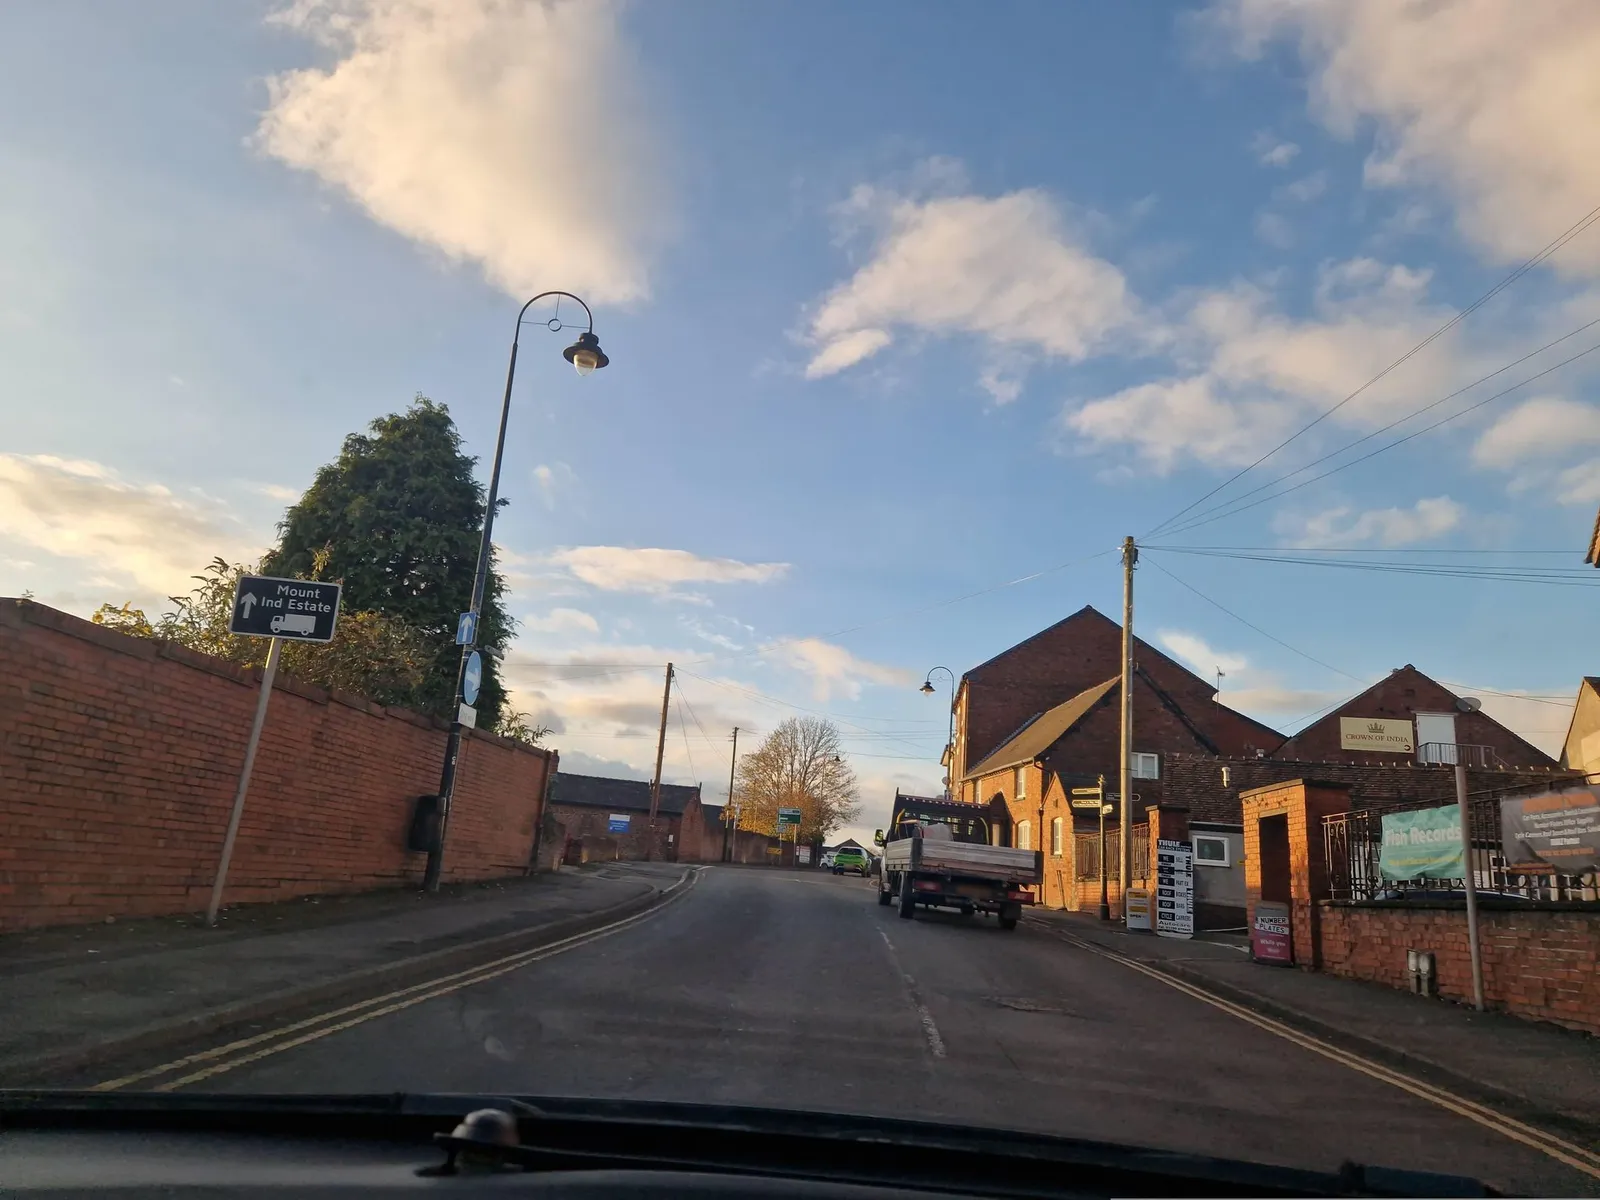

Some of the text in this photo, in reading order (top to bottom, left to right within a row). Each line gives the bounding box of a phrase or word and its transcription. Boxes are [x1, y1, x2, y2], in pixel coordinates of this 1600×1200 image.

[276, 584, 321, 599] Mount
[261, 596, 331, 613] Ind Estate
[1387, 735, 1409, 743] INDIA
[1409, 823, 1462, 845] Records
[1158, 839, 1180, 847] THULE
[1259, 924, 1285, 933] PLATES
